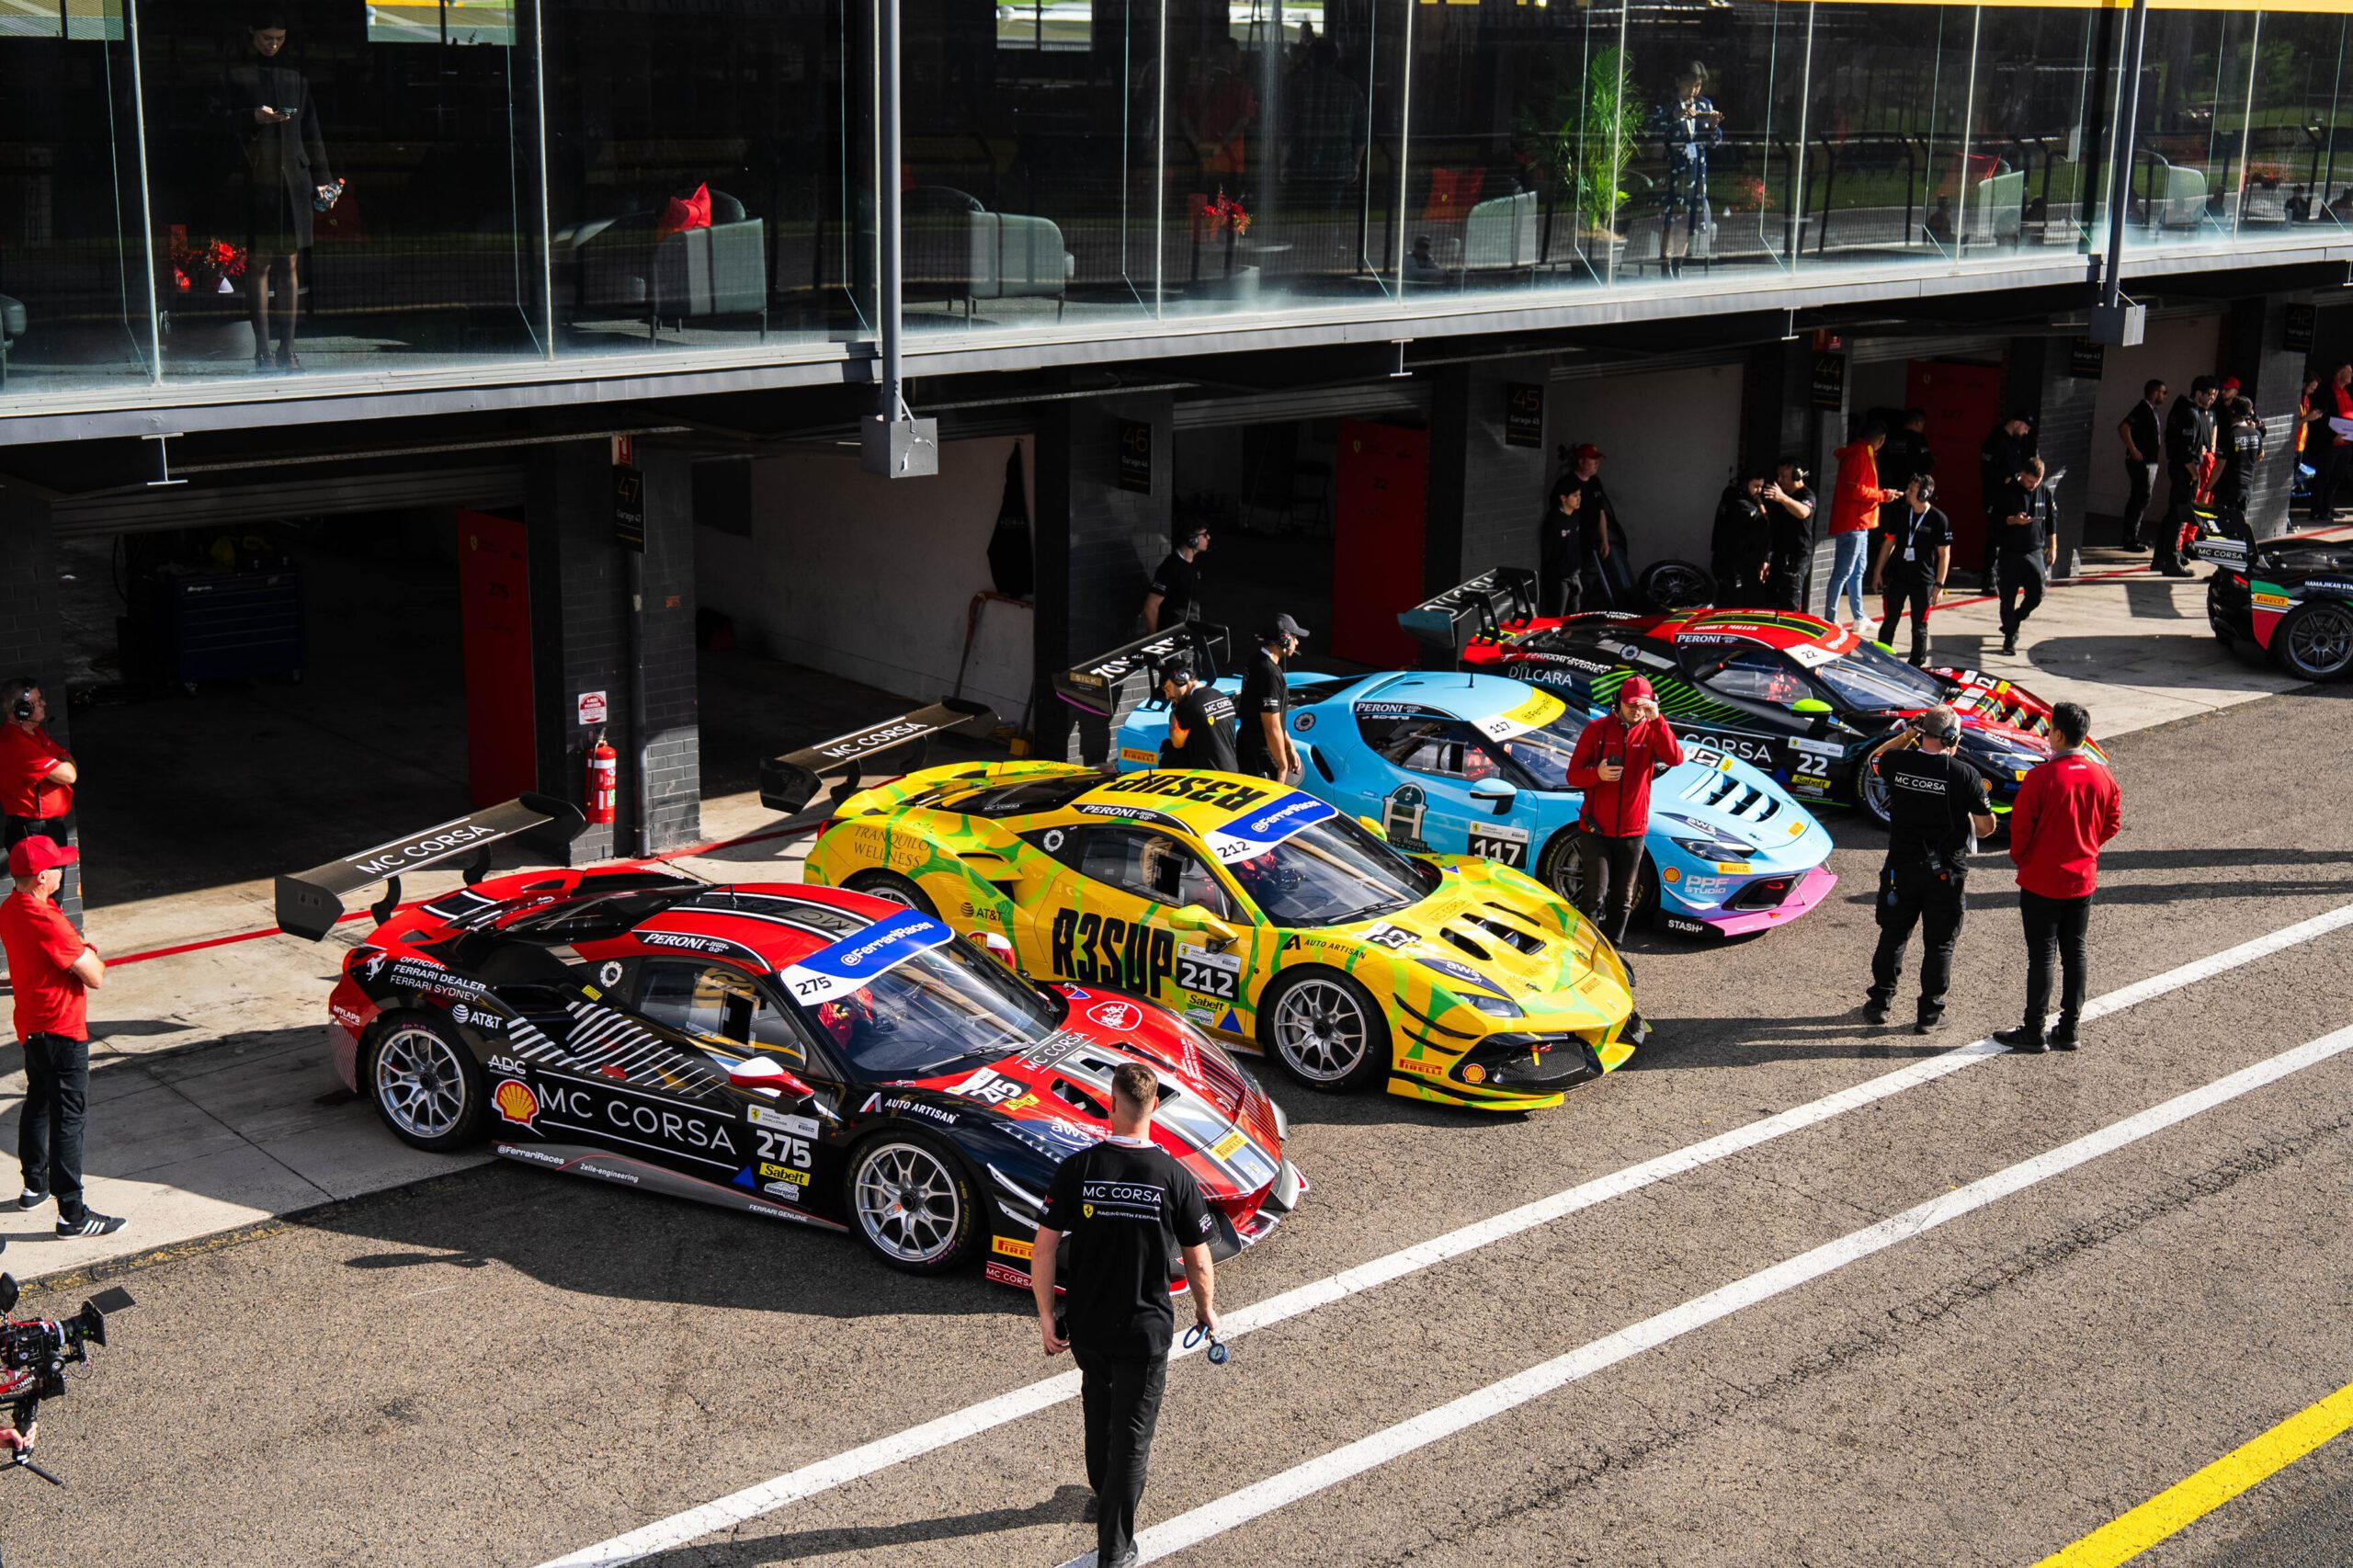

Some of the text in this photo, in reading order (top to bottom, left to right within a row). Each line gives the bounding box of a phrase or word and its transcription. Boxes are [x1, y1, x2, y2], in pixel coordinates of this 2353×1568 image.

[1513, 389, 1539, 411] 45
[1123, 426, 1148, 451] 46
[618, 476, 638, 502] 47
[2213, 550, 2243, 560] CORSA
[1677, 634, 1721, 643] PERONI
[1802, 650, 1818, 659] 22
[1567, 658, 1608, 675] SYDNEY
[1205, 705, 1217, 714] MC
[1356, 702, 1404, 713] PERONI
[1490, 721, 1511, 734] 117
[822, 722, 928, 759] MC CORSA
[1124, 749, 1155, 763] PIRELLI
[1797, 752, 1828, 777] 22
[1894, 775, 1946, 791] MC CORSA
[1081, 804, 1137, 818] PERONI
[1251, 800, 1322, 833] @FerrariRaces
[1686, 816, 1716, 833] aws
[853, 825, 930, 851] TRANQUILO
[356, 824, 495, 874] MC CORSA
[854, 841, 922, 868] WELLNESS
[1217, 841, 1251, 858] 212
[1473, 838, 1521, 866] 117
[1720, 864, 1750, 873] PIRELLI
[1684, 886, 1726, 895] STUDIO
[1686, 875, 1730, 888] PPF
[976, 909, 1004, 922] AT&T
[643, 933, 708, 950] PERONI
[840, 921, 935, 967] @FerrariRaces
[1304, 938, 1367, 960] AUTO ARTISAN
[1052, 907, 1176, 999] R3SUP
[400, 956, 447, 971] OFFICIAL
[1446, 960, 1481, 978] aws
[393, 964, 487, 992] FERRARI DEALER
[795, 976, 833, 996] 275
[1181, 962, 1233, 998] 212
[390, 974, 480, 1003] FERRARI SYDNEY
[1189, 994, 1224, 1012] Sabelt
[333, 1004, 361, 1024] MYLAPS
[470, 1011, 503, 1029] AT&T
[1022, 1031, 1088, 1073] MC CORSA
[488, 1054, 526, 1075] ADG
[1399, 1058, 1442, 1075] PIRELLI
[539, 1083, 736, 1155] MC CORSA
[884, 1098, 957, 1124] AUTO ARTISAN
[1051, 1120, 1092, 1142] aws
[497, 1145, 565, 1165] @FerrariRaces
[756, 1130, 812, 1168] 275
[1216, 1135, 1244, 1157] PIRELLI
[580, 1164, 640, 1184] 2elle-engineering
[765, 1165, 805, 1185] Sabelt
[1083, 1186, 1162, 1203] MC CORSA
[749, 1204, 809, 1222] FERRARI GENUINE
[986, 1267, 1001, 1278] MC
[9, 1374, 36, 1392] RONIN
